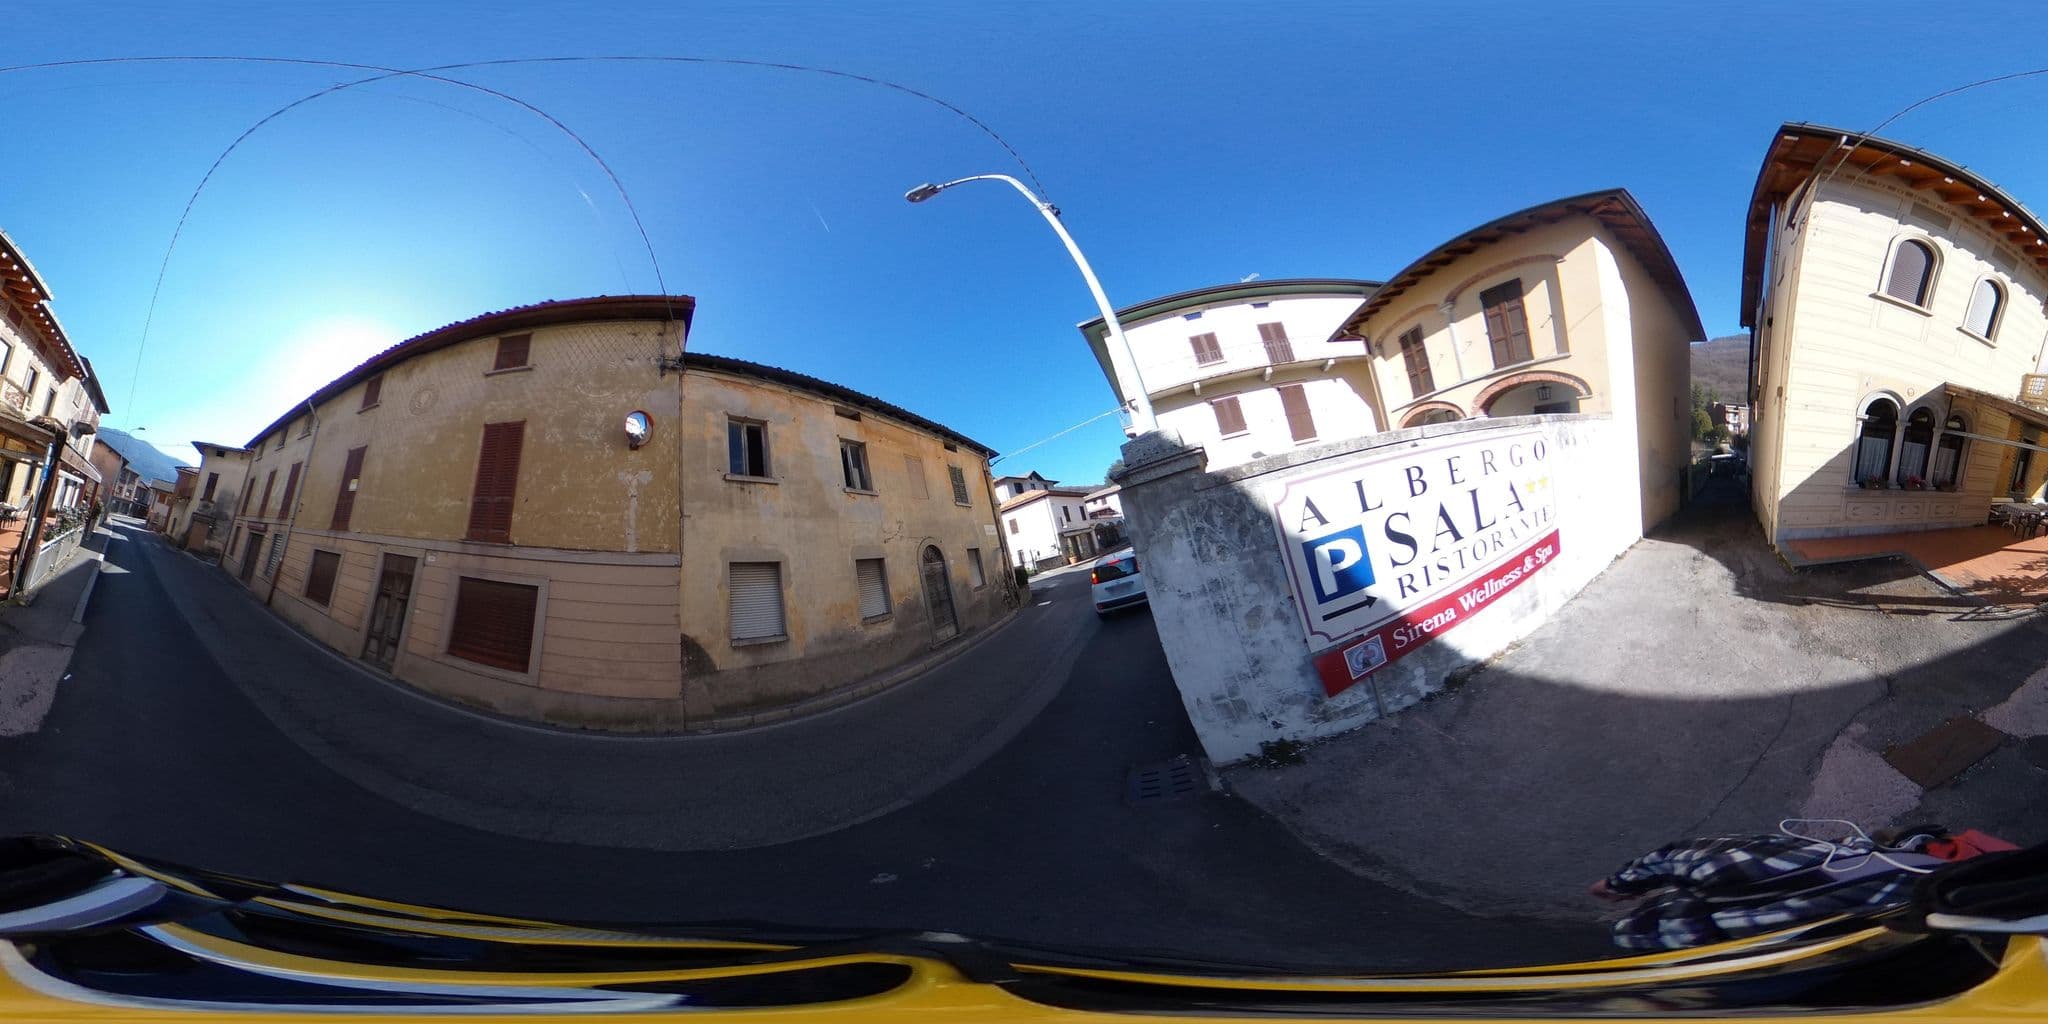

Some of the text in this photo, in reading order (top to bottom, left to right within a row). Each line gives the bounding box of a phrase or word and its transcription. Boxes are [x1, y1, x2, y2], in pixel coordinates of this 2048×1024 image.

[1299, 439, 1547, 533] ALBERGO
[1384, 479, 1526, 569] SALA
[1314, 537, 1364, 596] P
[1392, 542, 1553, 649] Sirena Wellness & Spa
[1397, 504, 1552, 601] RISTORANTE
